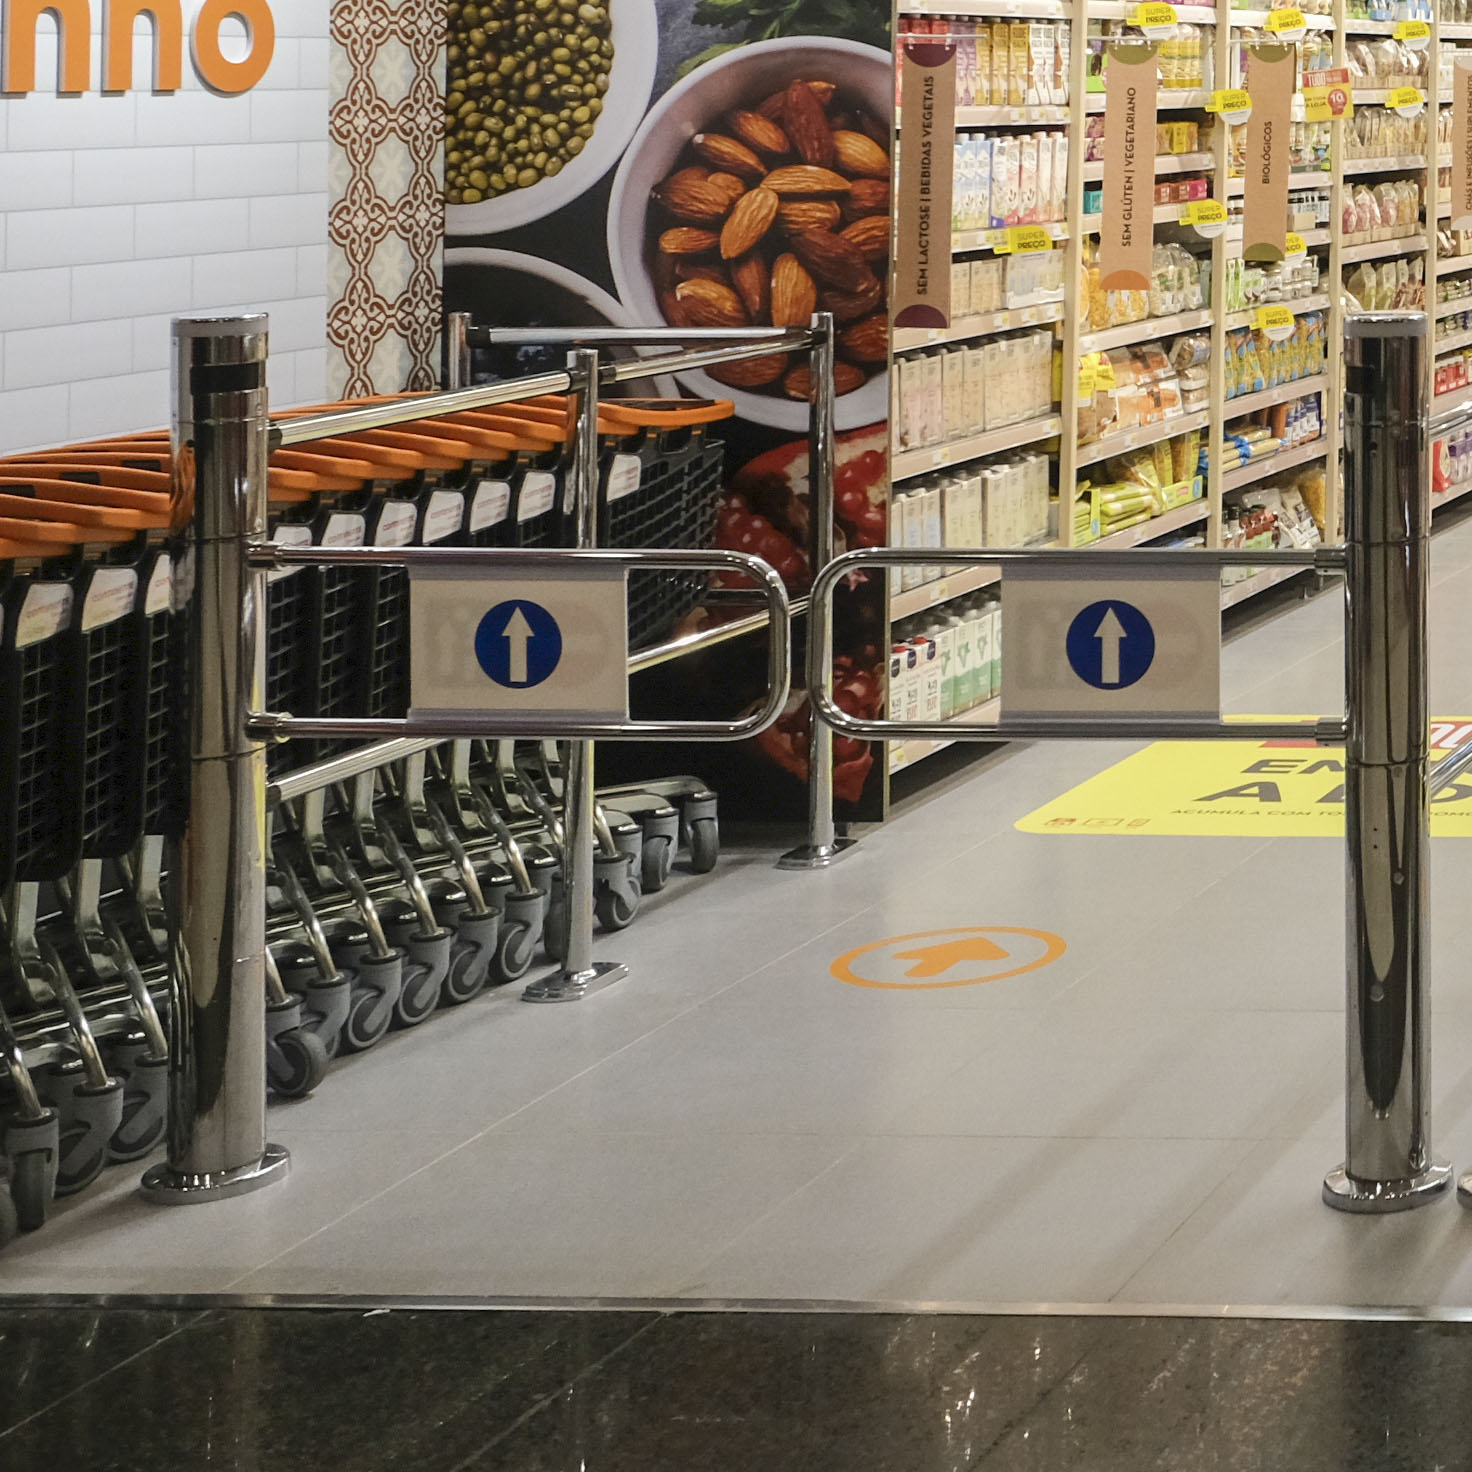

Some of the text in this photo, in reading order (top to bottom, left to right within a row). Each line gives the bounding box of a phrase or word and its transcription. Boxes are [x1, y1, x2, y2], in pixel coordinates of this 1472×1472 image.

[1145, 14, 1172, 24] PREÇO
[1222, 100, 1247, 110] PREÇO
[1261, 120, 1273, 185] BIOLÓGICOS
[1121, 87, 1136, 247] SEM GLÚTEN VEGETARIANO
[917, 76, 934, 296] SEM LACTOSE BEBIDAS VEGETAIS
[1197, 212, 1222, 222] PREÇO
[1017, 239, 1047, 250] PREÇO
[1191, 780, 1283, 803] A
[1170, 808, 1261, 816] ACUMULA
